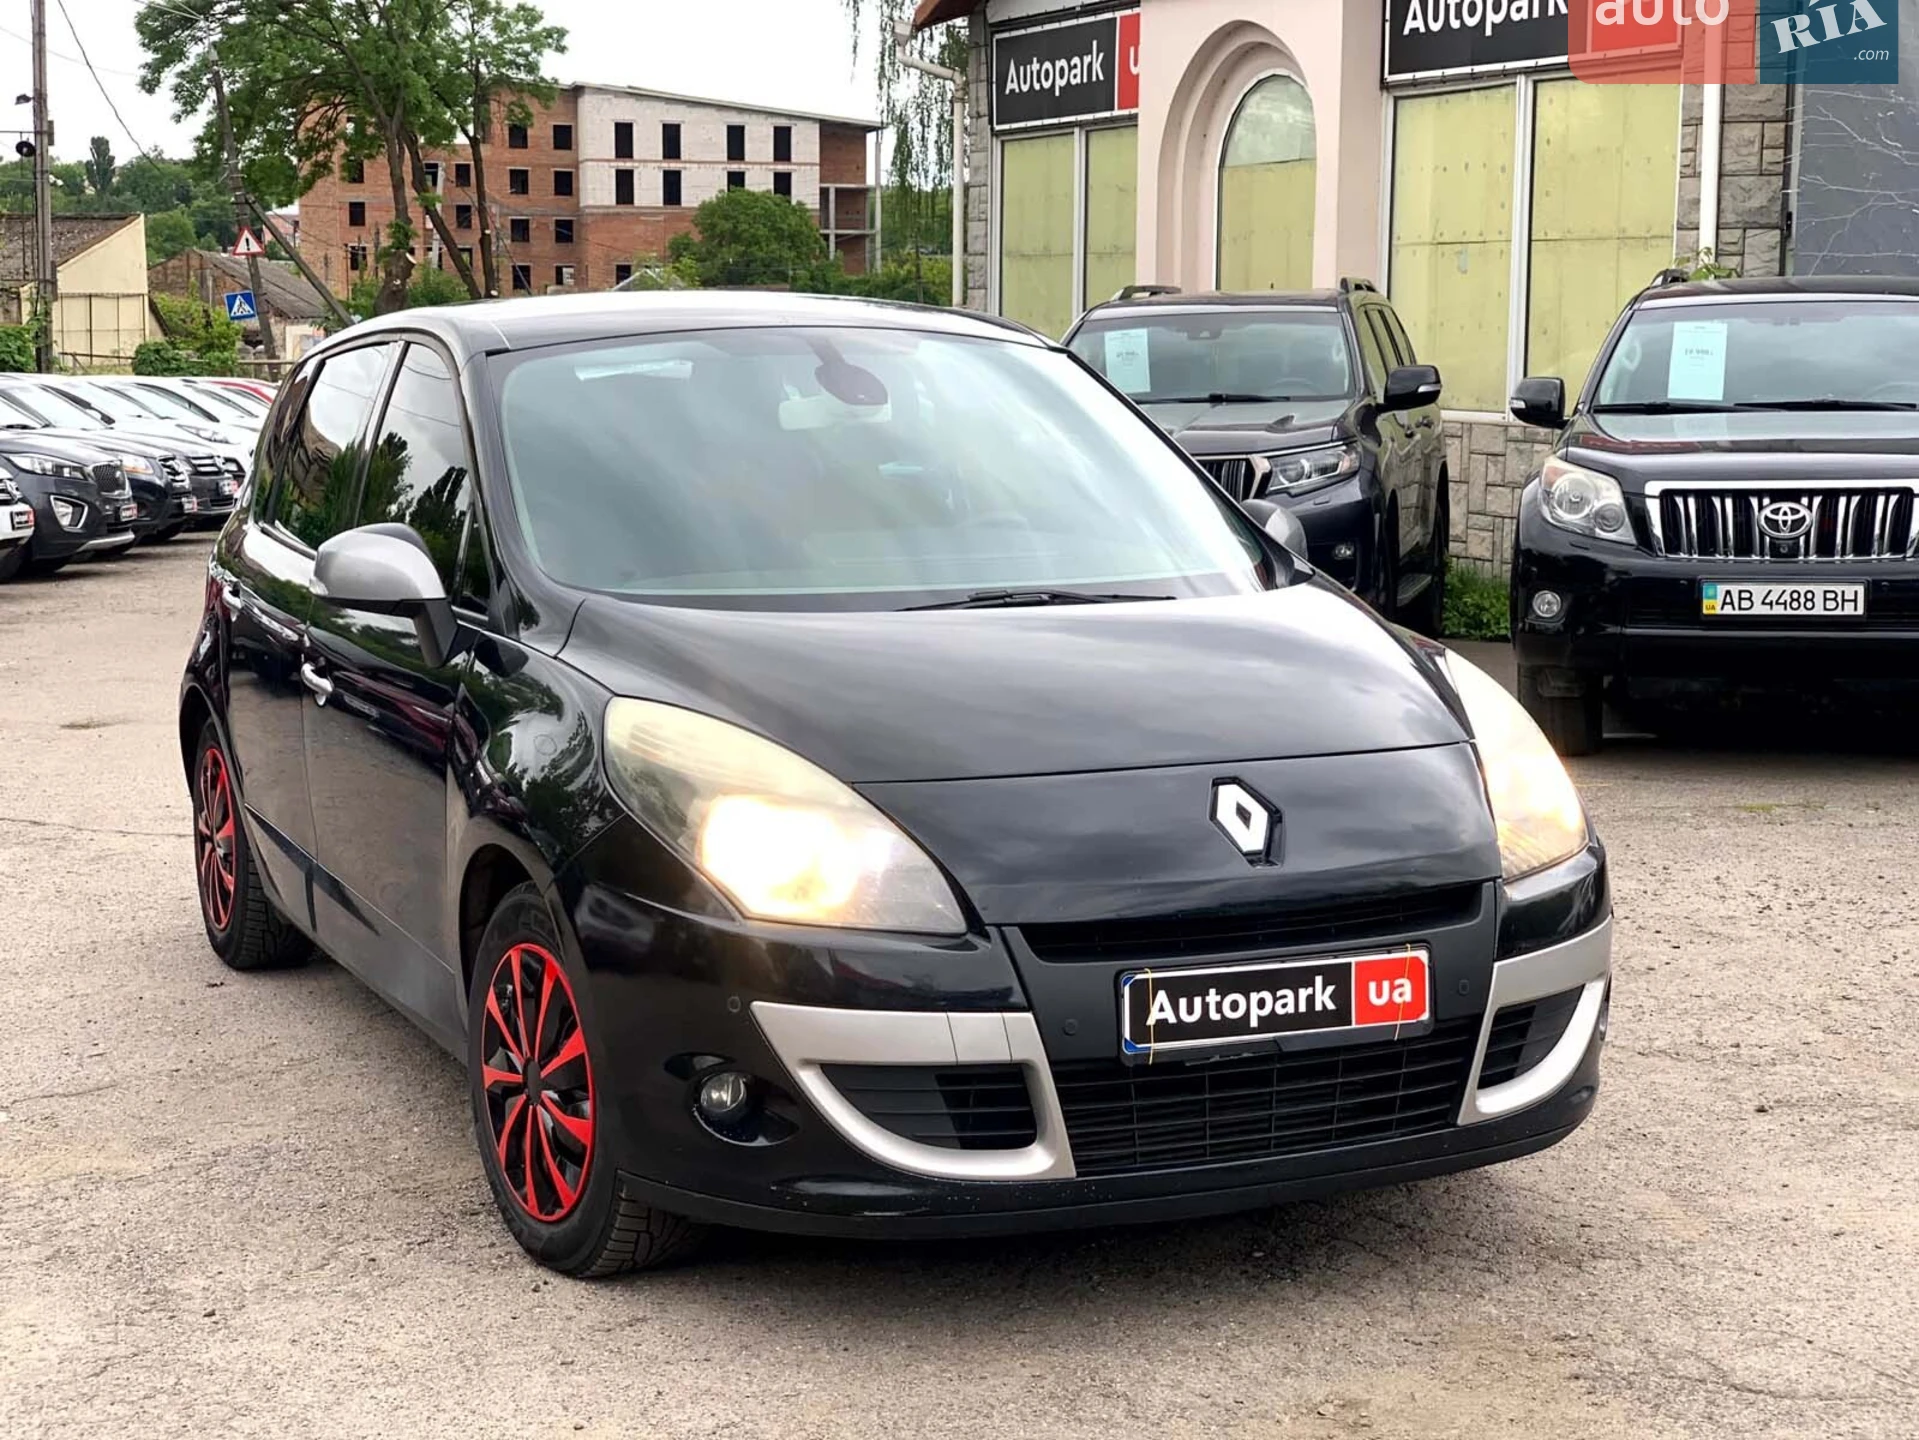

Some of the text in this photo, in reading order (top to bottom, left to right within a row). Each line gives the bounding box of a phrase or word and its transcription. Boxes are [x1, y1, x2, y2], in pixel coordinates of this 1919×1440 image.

[1403, 0, 1568, 36] Autopa
[1005, 39, 1105, 97] Autopark
[1761, 589, 1816, 611] 4488
[1145, 974, 1413, 1028] Autopark ua
